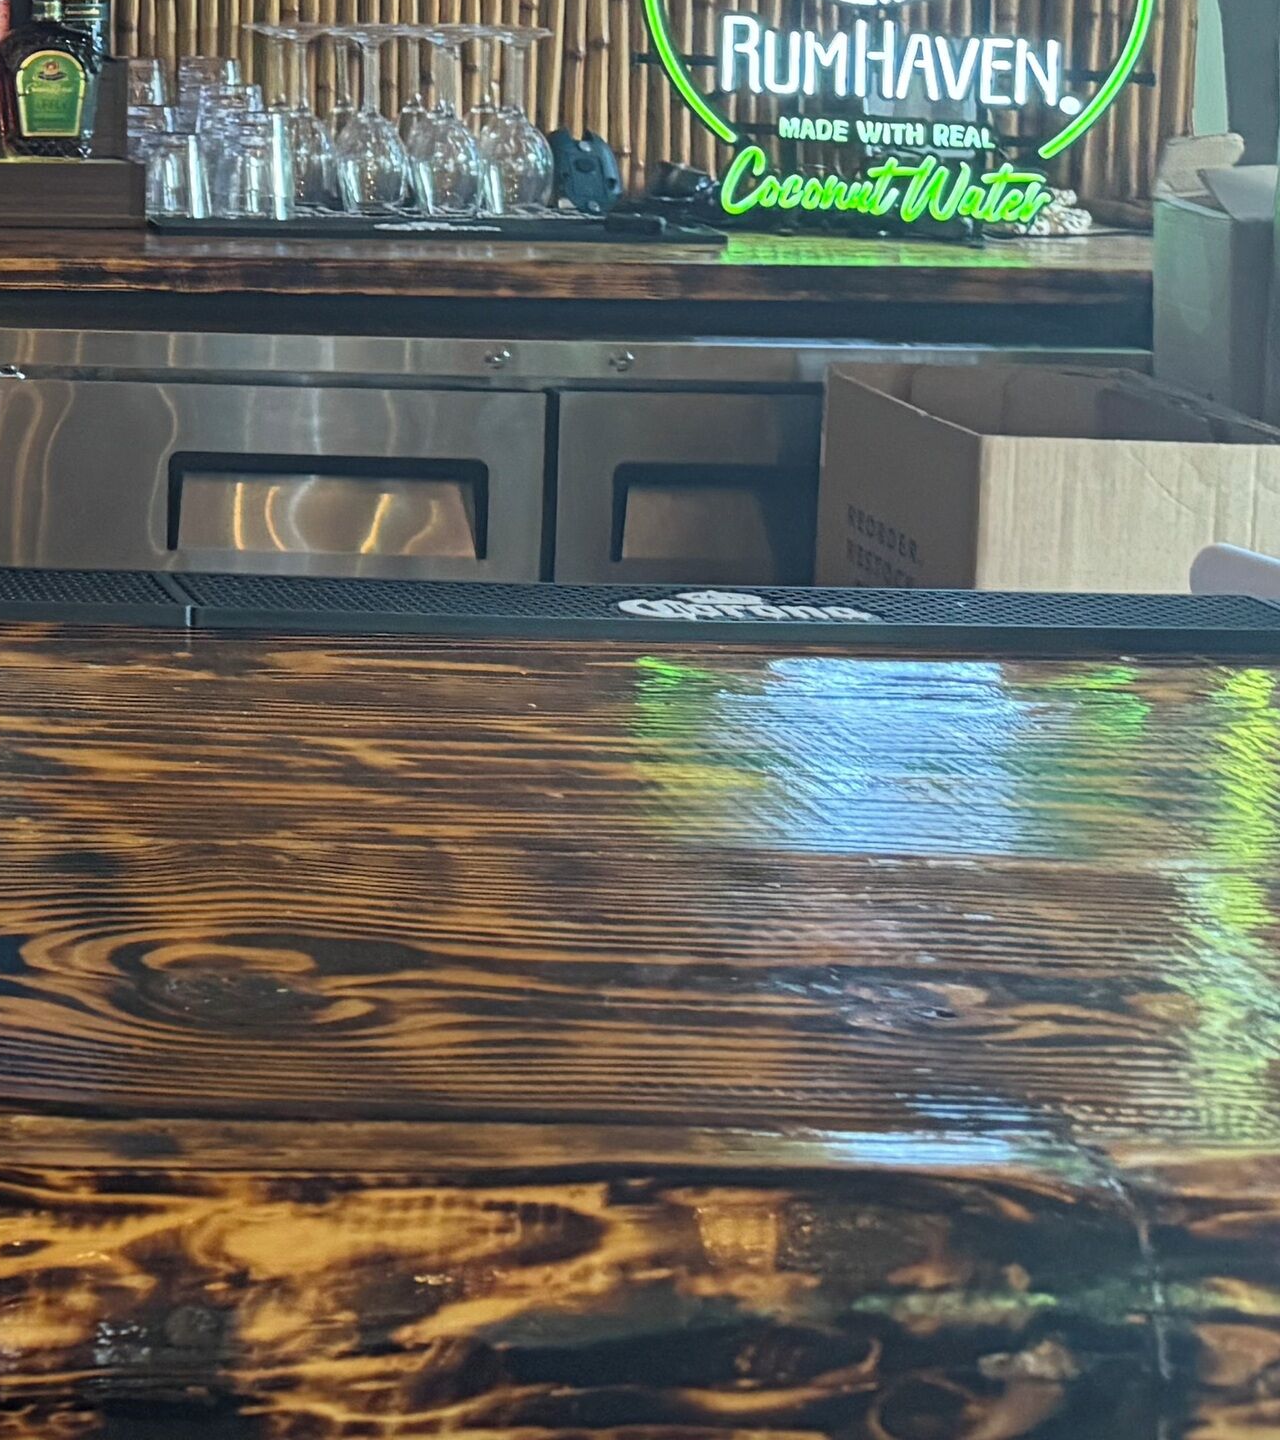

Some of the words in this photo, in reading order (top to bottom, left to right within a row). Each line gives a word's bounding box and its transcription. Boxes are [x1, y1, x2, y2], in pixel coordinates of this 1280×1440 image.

[778, 116, 848, 143] MADE
[857, 120, 923, 147] WITH
[932, 124, 996, 149] REAL
[721, 146, 900, 220] Coconut
[898, 154, 1052, 224] Water
[618, 598, 884, 622] Corona
